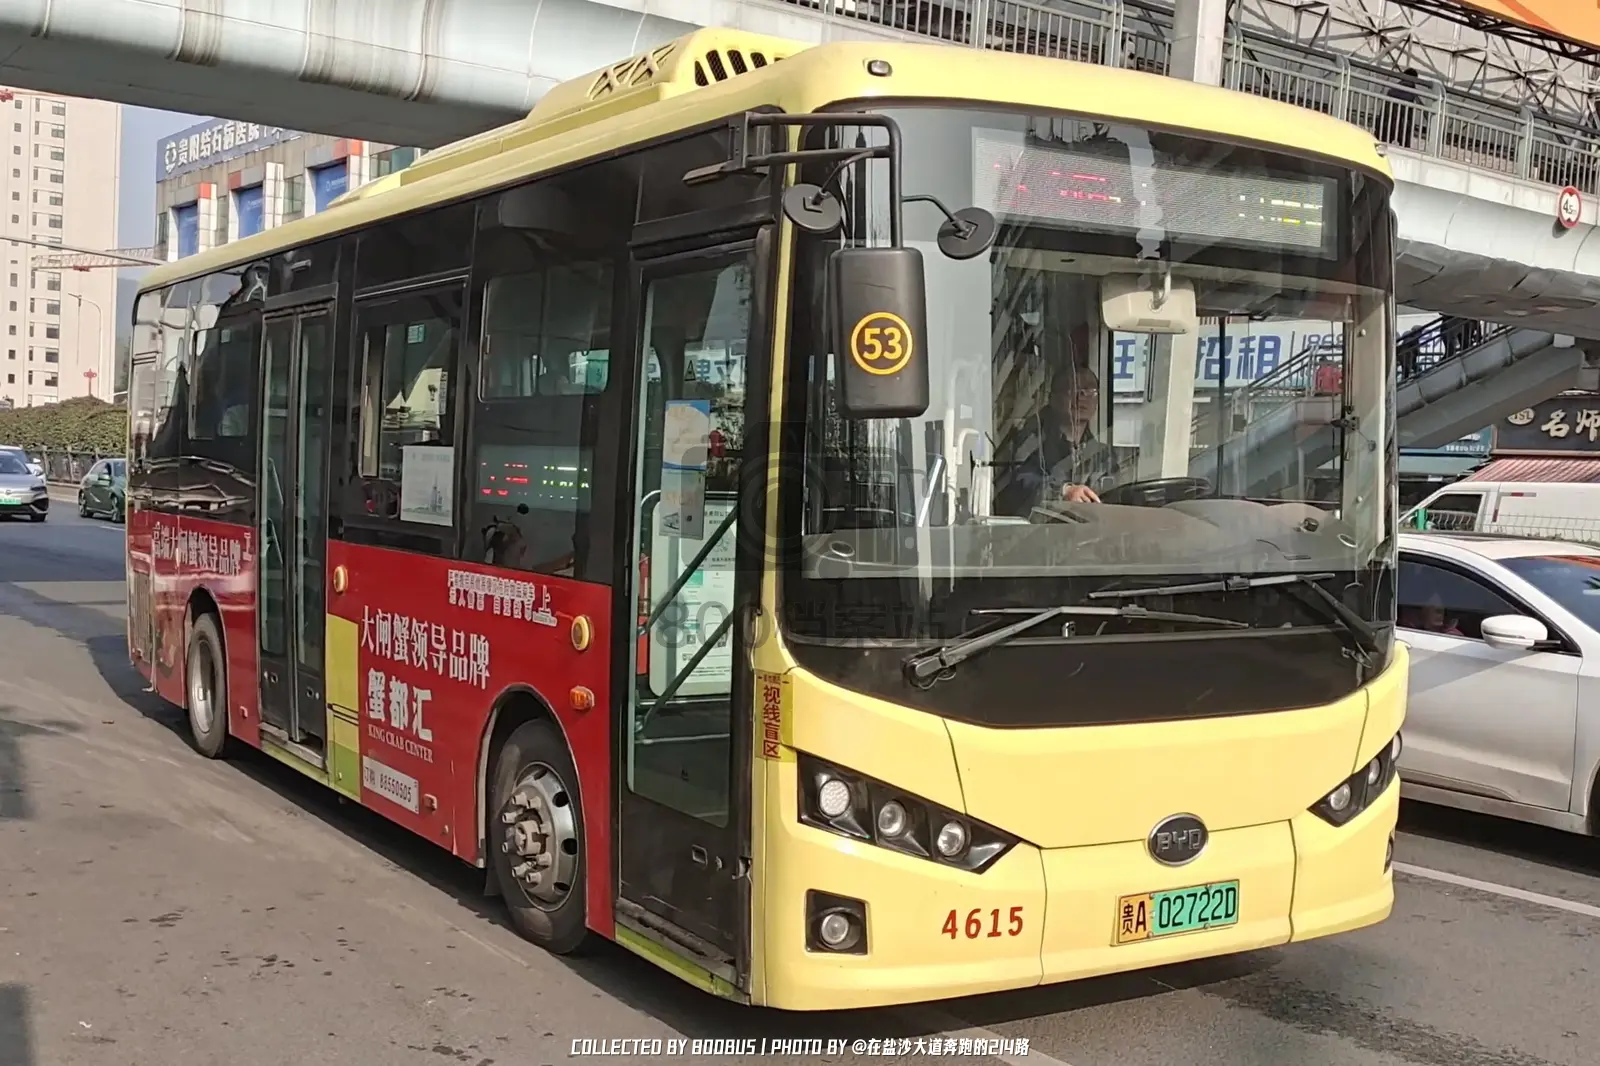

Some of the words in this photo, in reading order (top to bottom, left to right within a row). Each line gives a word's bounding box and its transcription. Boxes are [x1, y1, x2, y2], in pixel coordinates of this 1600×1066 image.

[863, 327, 902, 360] 53
[1541, 408, 1600, 442] 名师
[361, 605, 491, 690] 大闸蟹领导品牌
[368, 667, 433, 742] 蟹都汇
[763, 685, 782, 759] 视线盲区
[368, 723, 386, 743] KING
[386, 731, 405, 750] CRAB
[405, 739, 434, 764] CENTER
[1155, 828, 1202, 853] BYD
[941, 906, 1023, 940] 4615
